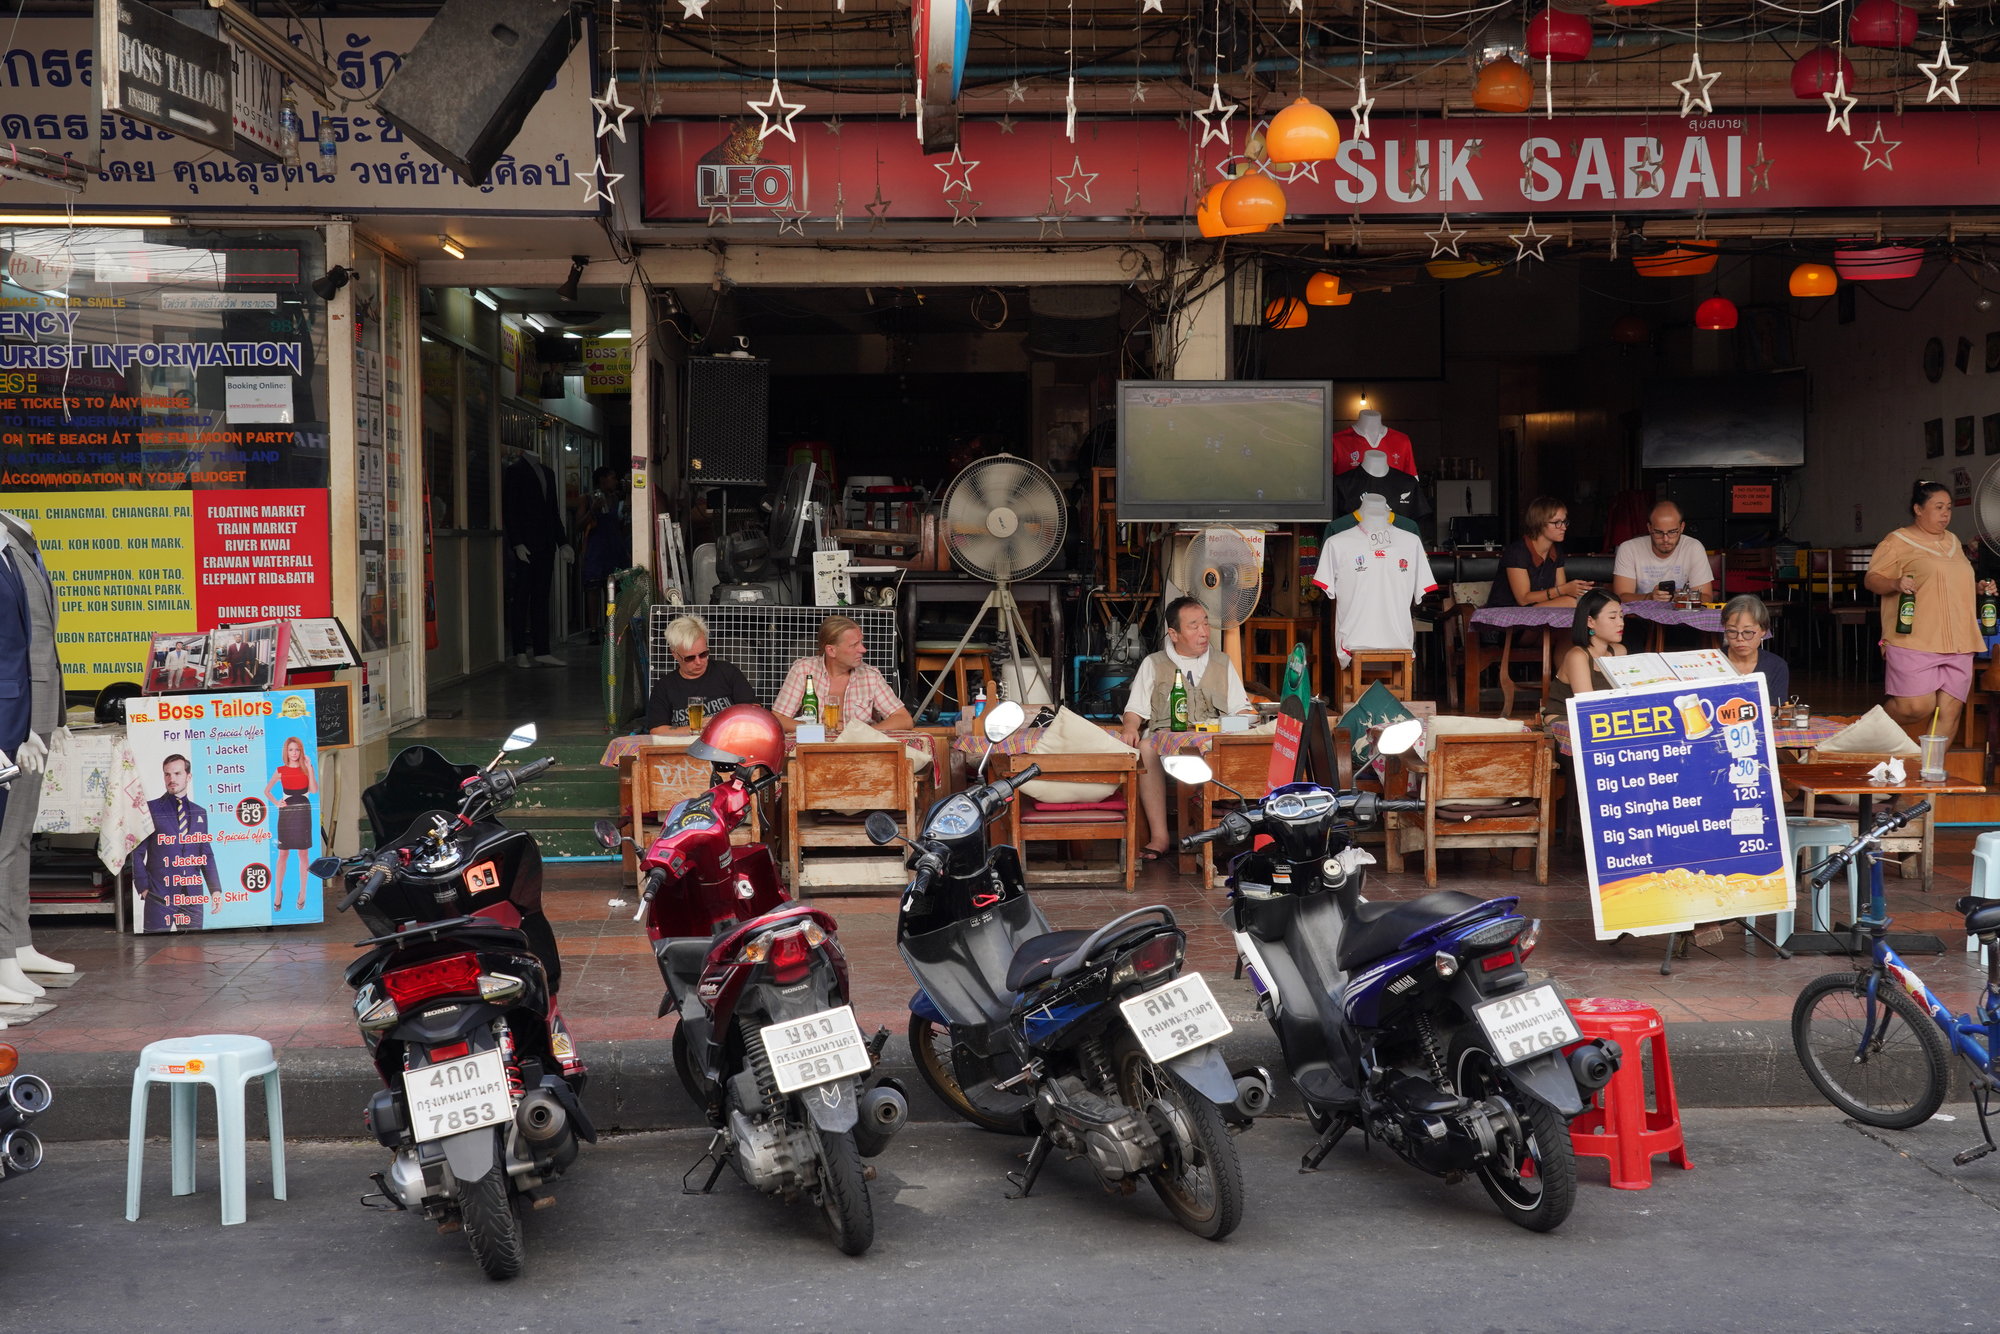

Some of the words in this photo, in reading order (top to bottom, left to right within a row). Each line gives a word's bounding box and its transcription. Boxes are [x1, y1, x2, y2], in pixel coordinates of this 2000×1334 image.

[119, 32, 162, 87] BOSS
[165, 53, 227, 112] TAILOR
[128, 86, 161, 117] INSIDE
[235, 102, 273, 132] HOSTEL
[1689, 119, 1741, 132] สุขสบาย
[1334, 137, 1483, 203] SUK
[1519, 135, 1742, 202] SABAI
[700, 165, 790, 206] LEO
[43, 297, 82, 308] YOUR
[87, 297, 126, 309] SMILE
[0, 311, 80, 343] ENCY
[585, 339, 600, 348] yes
[92, 342, 302, 377] INFORMATION
[586, 348, 617, 359] BOSS
[227, 382, 257, 391] Booking
[259, 382, 287, 390] Online:
[591, 376, 624, 386] BOSS
[22, 396, 80, 410] TICKETS
[86, 397, 104, 409] TO
[110, 394, 190, 412] ANYWHERE
[4, 415, 24, 427] TO
[28, 415, 54, 427] THE
[60, 415, 163, 429] UNDERWATER
[164, 415, 213, 427] WORLD
[2, 432, 23, 447] ON
[28, 432, 55, 445] THE
[60, 432, 108, 445] BEACH
[112, 430, 131, 445] AT
[136, 432, 164, 444] THE
[167, 432, 243, 447] FULLMOON
[246, 432, 294, 444] PARTY
[89, 452, 117, 464] THE
[187, 452, 205, 464] OF
[1, 471, 125, 488] ACCOMMODATION
[128, 473, 143, 487] IN
[147, 473, 187, 485] YOUR
[191, 470, 247, 483] BUDGET
[207, 506, 259, 518] FLOATING
[261, 505, 306, 517] MARKET
[217, 523, 250, 535] TRAIN
[252, 522, 298, 534] MARKET
[68, 539, 90, 550] KOH
[127, 538, 149, 549] KOH
[225, 539, 258, 551] RIVER
[260, 538, 291, 551] KWAI
[203, 556, 250, 569] ERAWAN
[251, 555, 313, 568] WATERFALL
[139, 569, 160, 580] KOH
[202, 572, 256, 585] ELEPHANT
[258, 571, 315, 585] RID&BATH
[103, 584, 152, 596] NATIONAL
[87, 600, 109, 612] KOH
[218, 606, 259, 618] DINNER
[260, 605, 302, 617] CRUISE
[56, 631, 85, 643] UBON
[87, 631, 157, 643] RATCHATHAN
[93, 662, 144, 674] MALAYSIA
[130, 713, 155, 723] YES...
[158, 702, 204, 721] Boss
[210, 699, 273, 718] Tailors
[1590, 706, 1674, 739] BEER
[163, 730, 180, 741] For
[184, 728, 205, 740] Men
[209, 726, 243, 739] Spicial
[244, 725, 264, 739] offer
[1729, 725, 1751, 749] 90
[206, 746, 211, 755] 1
[215, 744, 248, 755] Jacket
[1593, 752, 1615, 767] Big
[1618, 748, 1660, 764] Chang
[1663, 743, 1692, 758] Beer
[207, 765, 212, 774] 1
[216, 763, 245, 775] Pants
[1736, 759, 1754, 776] 90
[208, 784, 213, 793] 1
[217, 783, 242, 794] Shirt
[1596, 778, 1618, 793] Big
[1622, 775, 1645, 789] Leo
[1649, 771, 1679, 785] Beer
[1733, 787, 1766, 802] 120.-
[209, 804, 214, 813] 1
[218, 802, 234, 813] Tie
[241, 801, 261, 811] Euro
[1600, 804, 1622, 819] Big
[1625, 798, 1669, 816] Singha
[1673, 794, 1702, 809] Beer
[240, 809, 262, 824] 69
[157, 833, 176, 845] For
[179, 831, 213, 844] Ladies
[216, 829, 250, 842] Spicial
[250, 830, 272, 843] offer
[1603, 830, 1625, 844] Big
[1628, 826, 1653, 840] San
[1657, 819, 1700, 839] Miguel
[1702, 817, 1731, 832] Beer
[1739, 840, 1773, 853] 250.-
[163, 857, 169, 867] 1
[172, 855, 207, 867] Jacket
[1606, 853, 1653, 870] Bucket
[163, 876, 169, 886] 1
[172, 874, 203, 886] Pants
[246, 868, 266, 877] Euro
[246, 875, 267, 890] 69
[164, 895, 170, 906] 1
[173, 894, 209, 905] Blouse
[224, 891, 249, 903] Skirt
[165, 915, 170, 925] 1
[173, 914, 191, 925] Tie
[782, 984, 809, 995] HONDA
[1387, 974, 1418, 996] YAMAHA
[423, 1005, 458, 1018] HONDA
[1141, 1001, 1213, 1039] กรุงเทพมหานคร
[1491, 1007, 1565, 1041] กรุงเทพมหานคร
[1171, 1023, 1204, 1048] 32
[1508, 1025, 1567, 1059] 8766
[430, 1061, 480, 1088] 4กด
[798, 1054, 845, 1081] 261
[416, 1081, 501, 1114] กรุงเทพมหานคร
[429, 1103, 496, 1135] 7853
